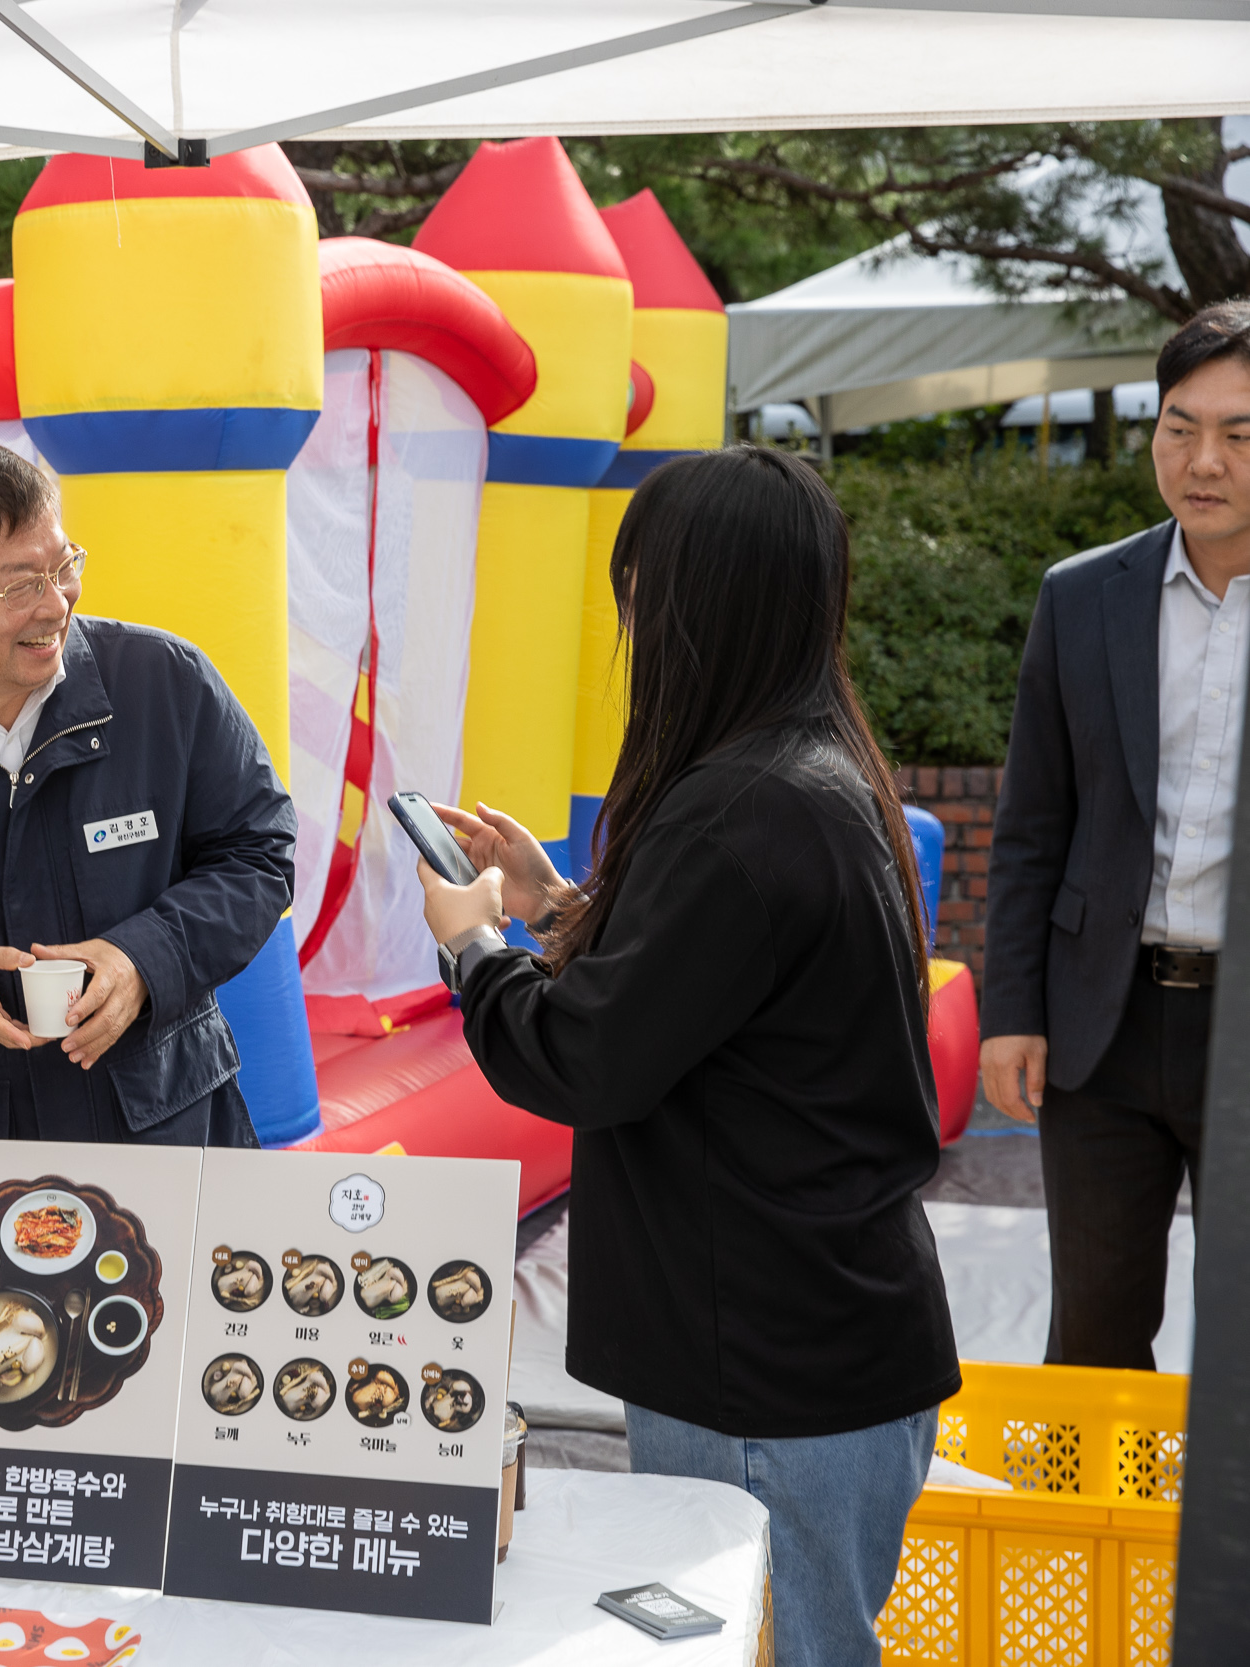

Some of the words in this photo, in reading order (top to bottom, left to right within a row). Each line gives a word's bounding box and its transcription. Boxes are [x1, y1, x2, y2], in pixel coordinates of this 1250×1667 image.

[341, 1188, 363, 1201] 지호
[224, 1322, 249, 1337] 건강
[295, 1326, 320, 1341] 미용
[214, 1426, 239, 1441] 들깨
[359, 1437, 398, 1453] 흑마늘
[437, 1442, 464, 1458] 능이
[5, 1465, 127, 1499] 한방육수와
[26, 1497, 74, 1526] 만든
[199, 1495, 261, 1521] 누구나
[265, 1500, 347, 1529] 취향대로
[352, 1507, 394, 1533] 즐길
[400, 1512, 421, 1534] 수
[427, 1513, 469, 1539] 있는
[240, 1527, 344, 1571] 다양한
[352, 1536, 421, 1577] 메뉴
